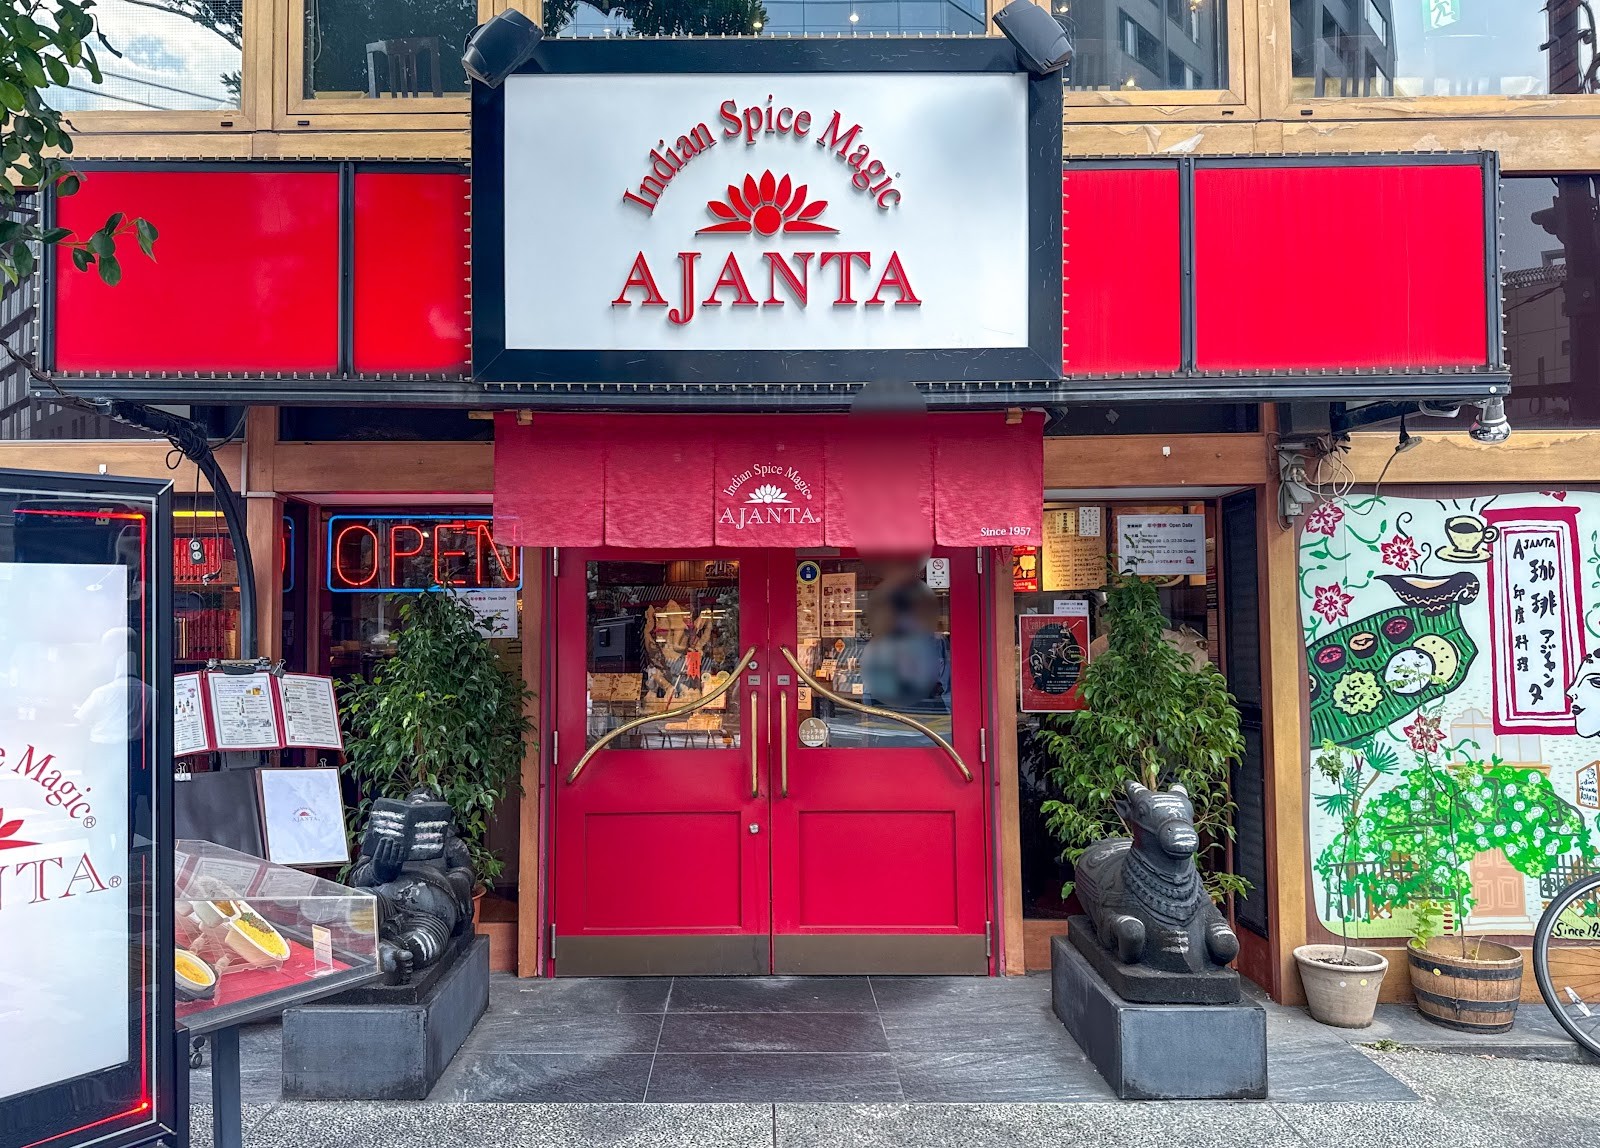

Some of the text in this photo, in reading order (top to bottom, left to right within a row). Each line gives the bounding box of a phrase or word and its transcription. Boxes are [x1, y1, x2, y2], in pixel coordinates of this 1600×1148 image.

[623, 94, 903, 215] Indian Spice Magic
[611, 250, 922, 327] AJANTA
[723, 462, 811, 497] Indian Spice Magic
[718, 507, 817, 530] AJANTA
[980, 526, 1031, 537] Since 1957
[335, 523, 518, 586] OPEN
[1512, 537, 1556, 561] AJANTA
[1528, 558, 1558, 619] 珈琲
[1512, 583, 1529, 672] 印度料理
[1554, 922, 1600, 938] Since 19
